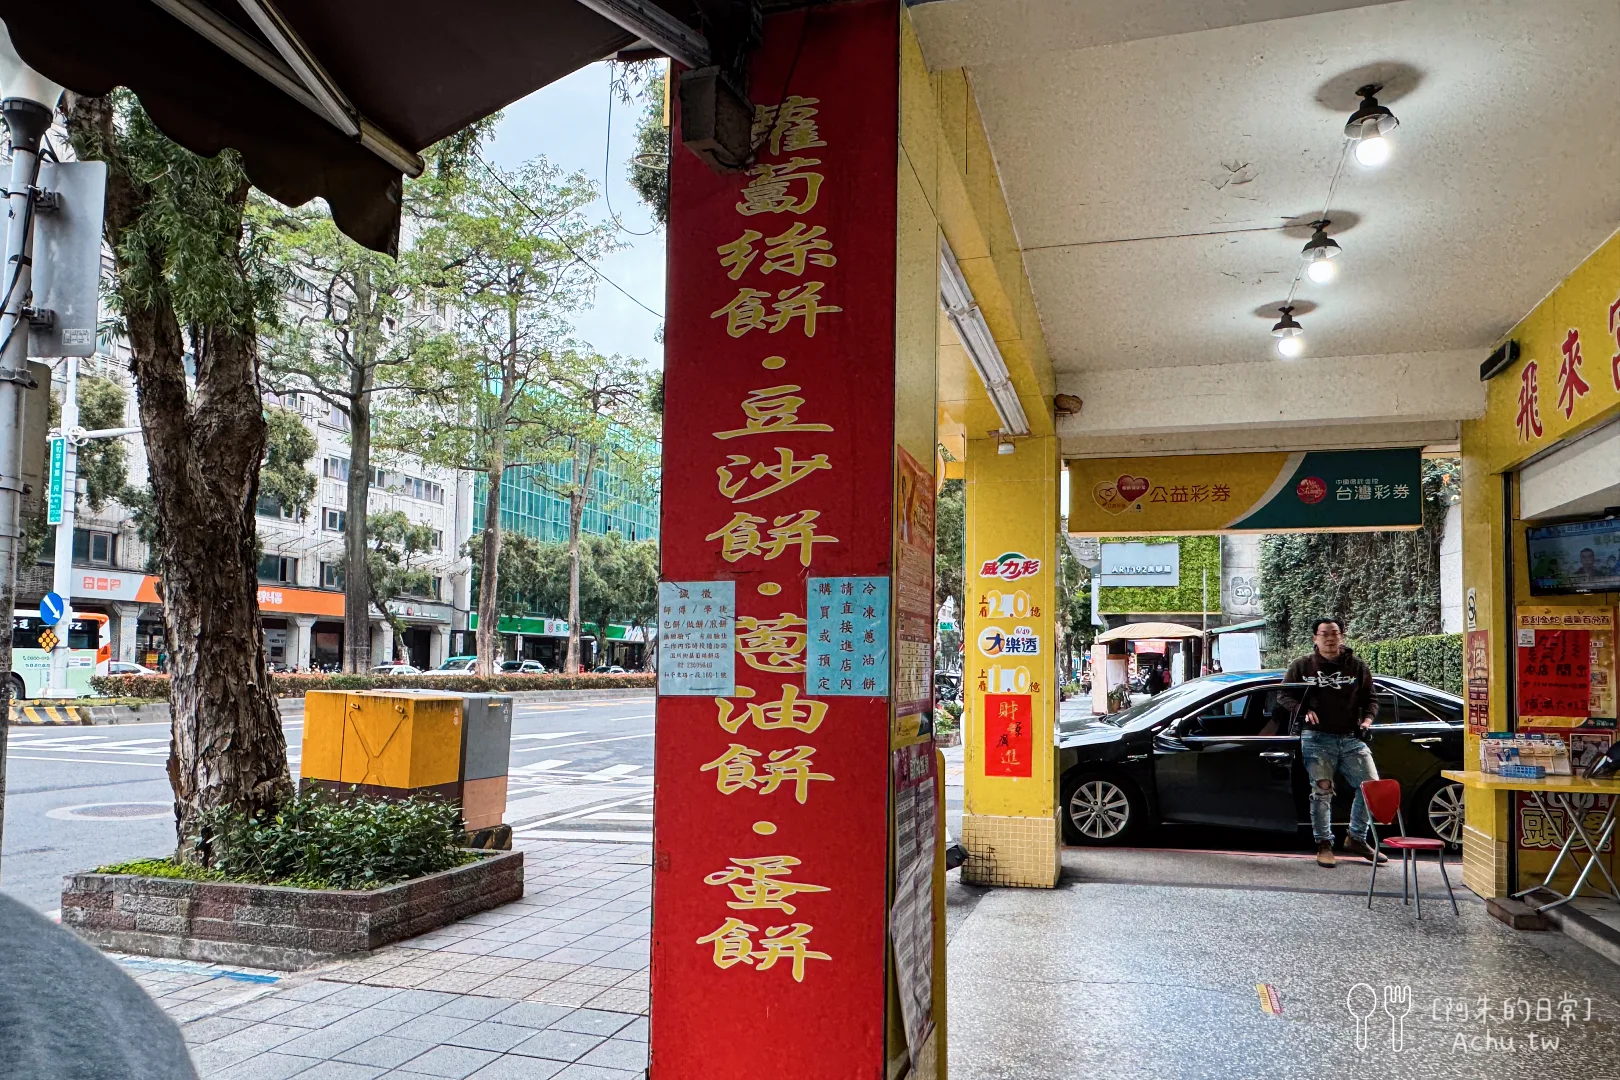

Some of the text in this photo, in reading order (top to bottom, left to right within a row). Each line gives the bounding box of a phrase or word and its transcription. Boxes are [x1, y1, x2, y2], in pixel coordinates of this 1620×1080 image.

[1516, 297, 1620, 442] 飛來
[1149, 483, 1230, 503] 公益彩券
[1335, 484, 1410, 501] 台灣彩券
[980, 560, 1039, 577] 威力彩
[986, 590, 1030, 618] 2.0
[818, 581, 832, 691] 購買或預定
[840, 581, 854, 691] 請直接進店內
[983, 632, 1038, 654] 大樂透
[991, 664, 1031, 695] 1.0
